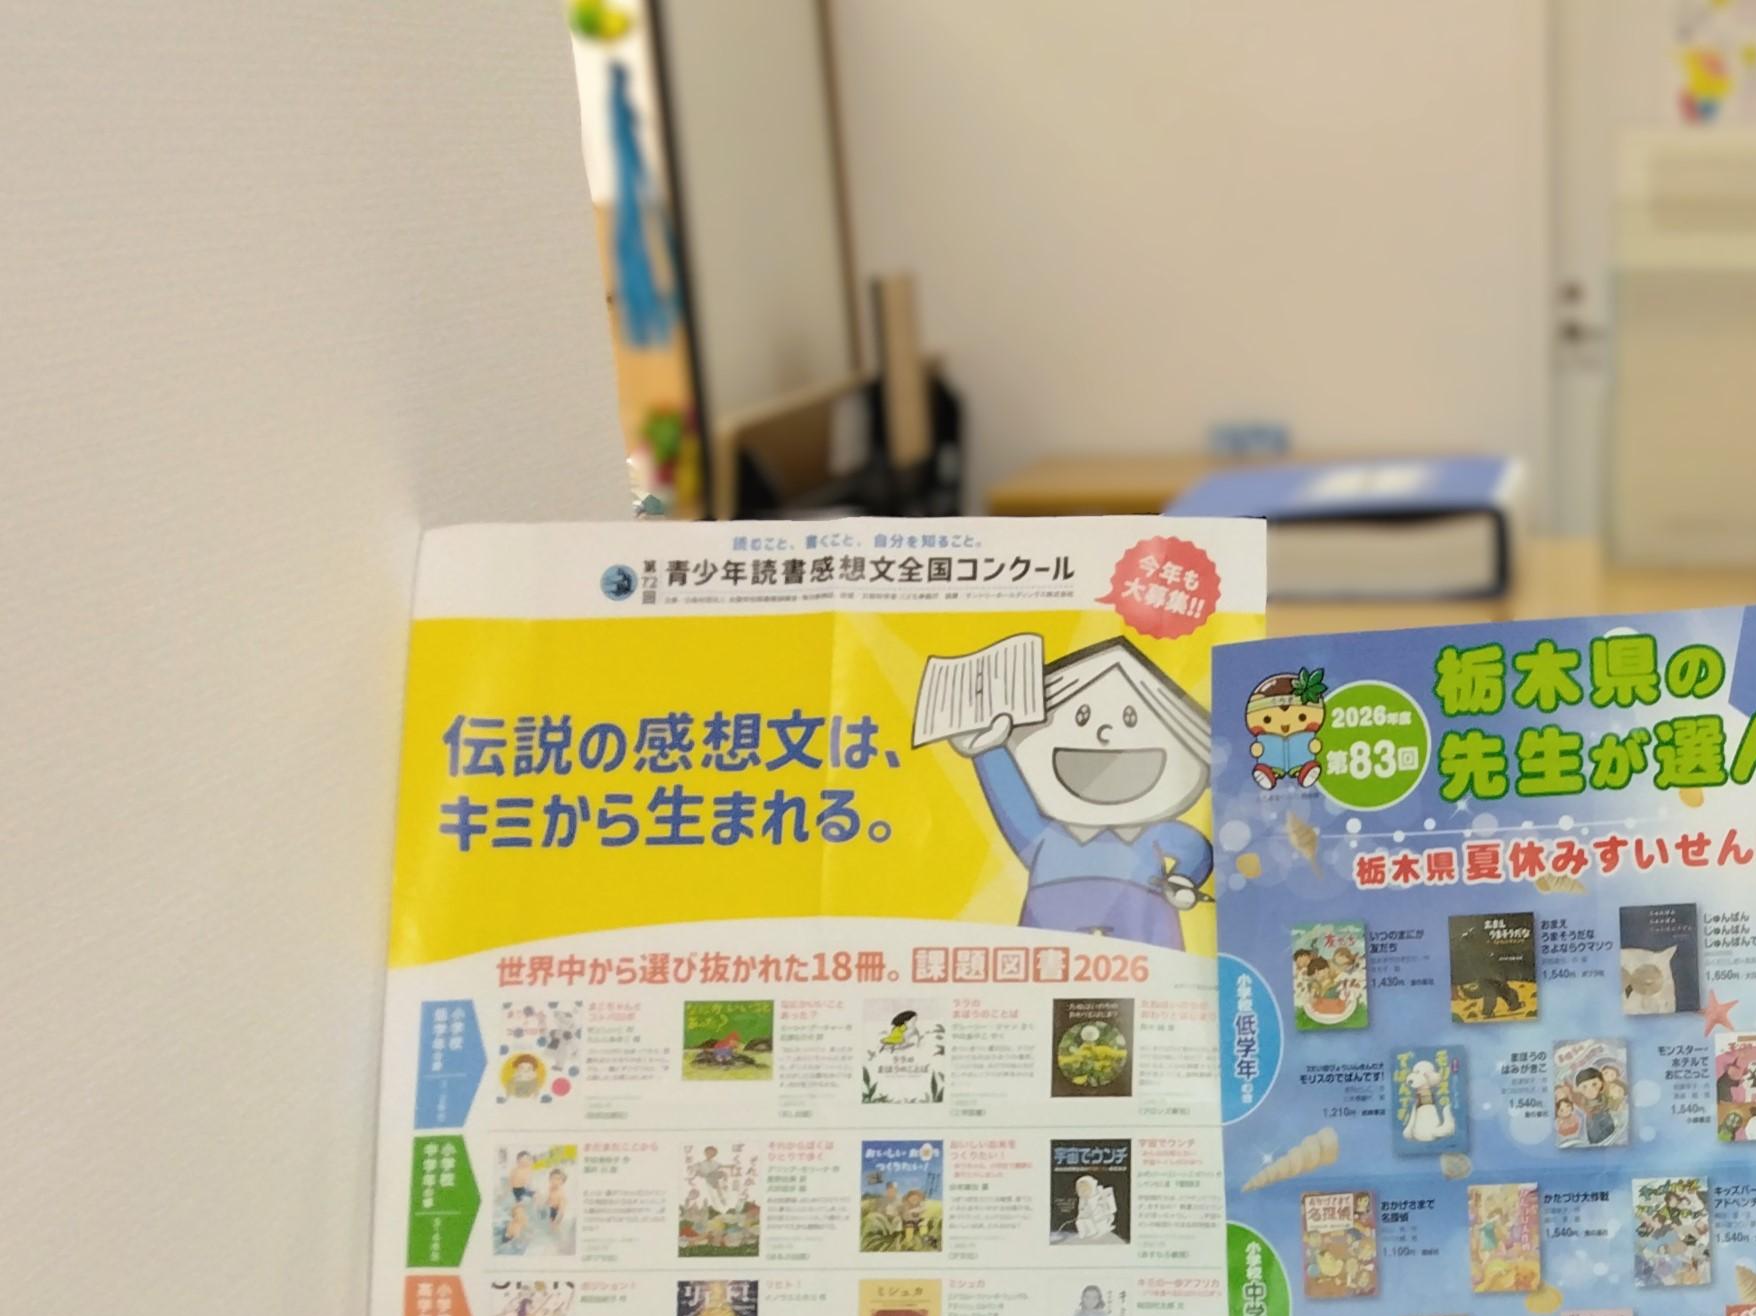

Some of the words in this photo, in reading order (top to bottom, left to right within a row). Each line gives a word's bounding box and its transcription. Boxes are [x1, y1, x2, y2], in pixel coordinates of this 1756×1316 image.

[665, 555, 1077, 588] 青少年読書感想文全国コンクール
[1138, 554, 1201, 592] 今年も
[1434, 633, 1727, 718] 栃木県の
[442, 710, 901, 777] 伝説の感想文は、
[1325, 739, 1419, 780] 第83回
[438, 787, 893, 853] キミから生まれる。
[496, 951, 901, 987] 世界中から選び抜かれた18冊。
